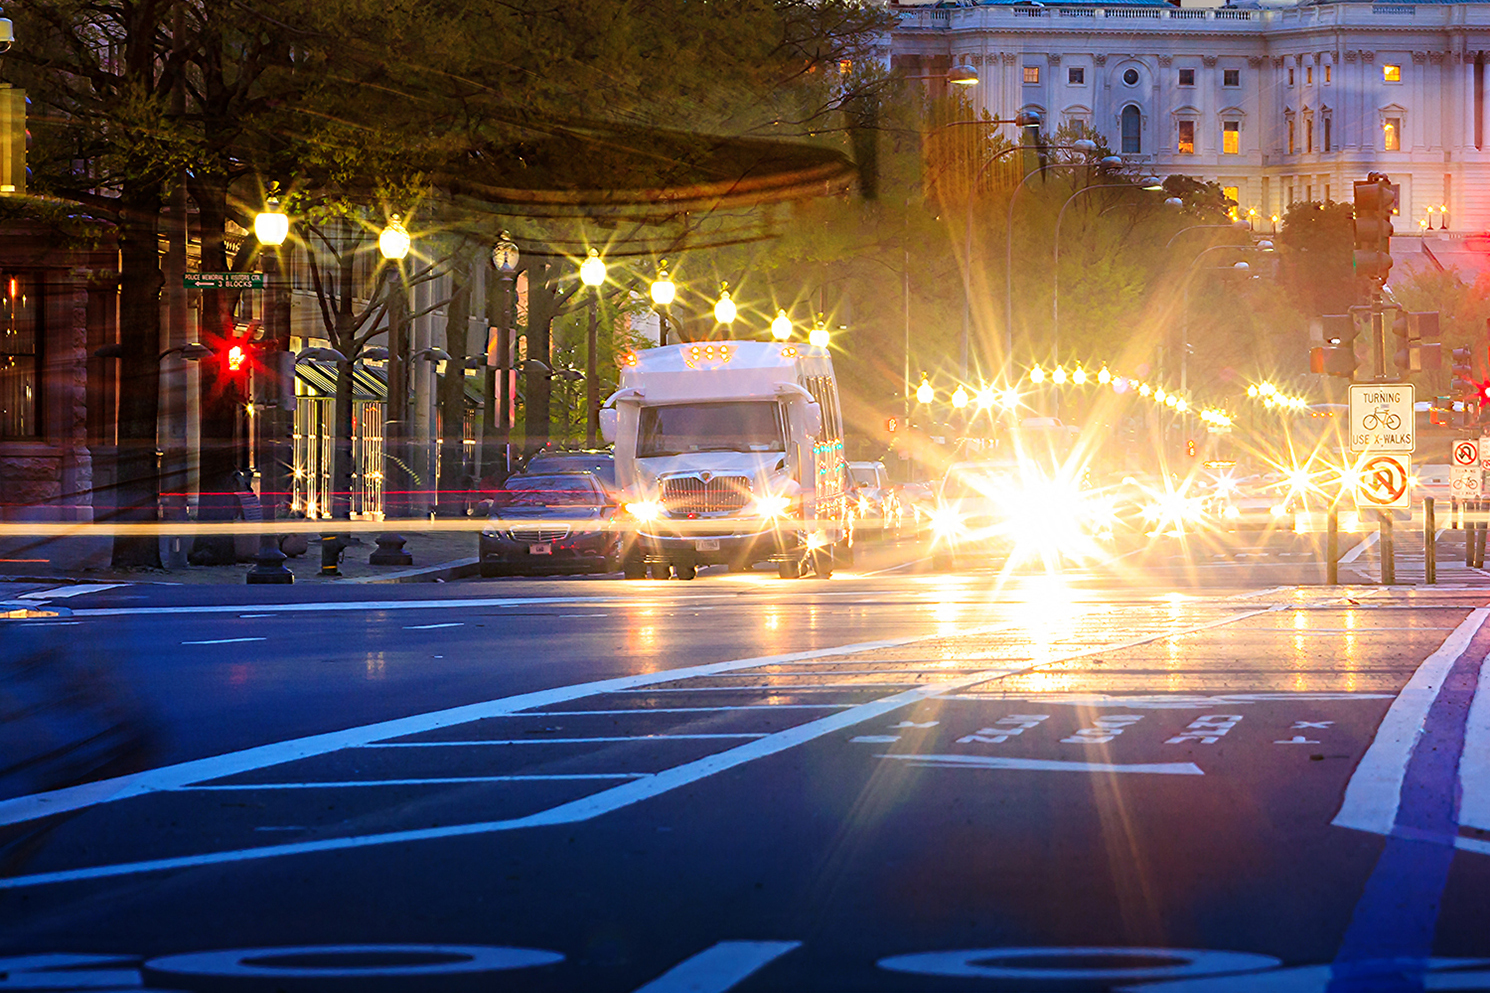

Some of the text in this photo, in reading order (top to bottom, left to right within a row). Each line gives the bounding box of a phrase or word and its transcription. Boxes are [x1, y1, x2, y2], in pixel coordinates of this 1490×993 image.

[1363, 392, 1401, 403] TURNING
[1353, 433, 1411, 445] USE X-WALKS
